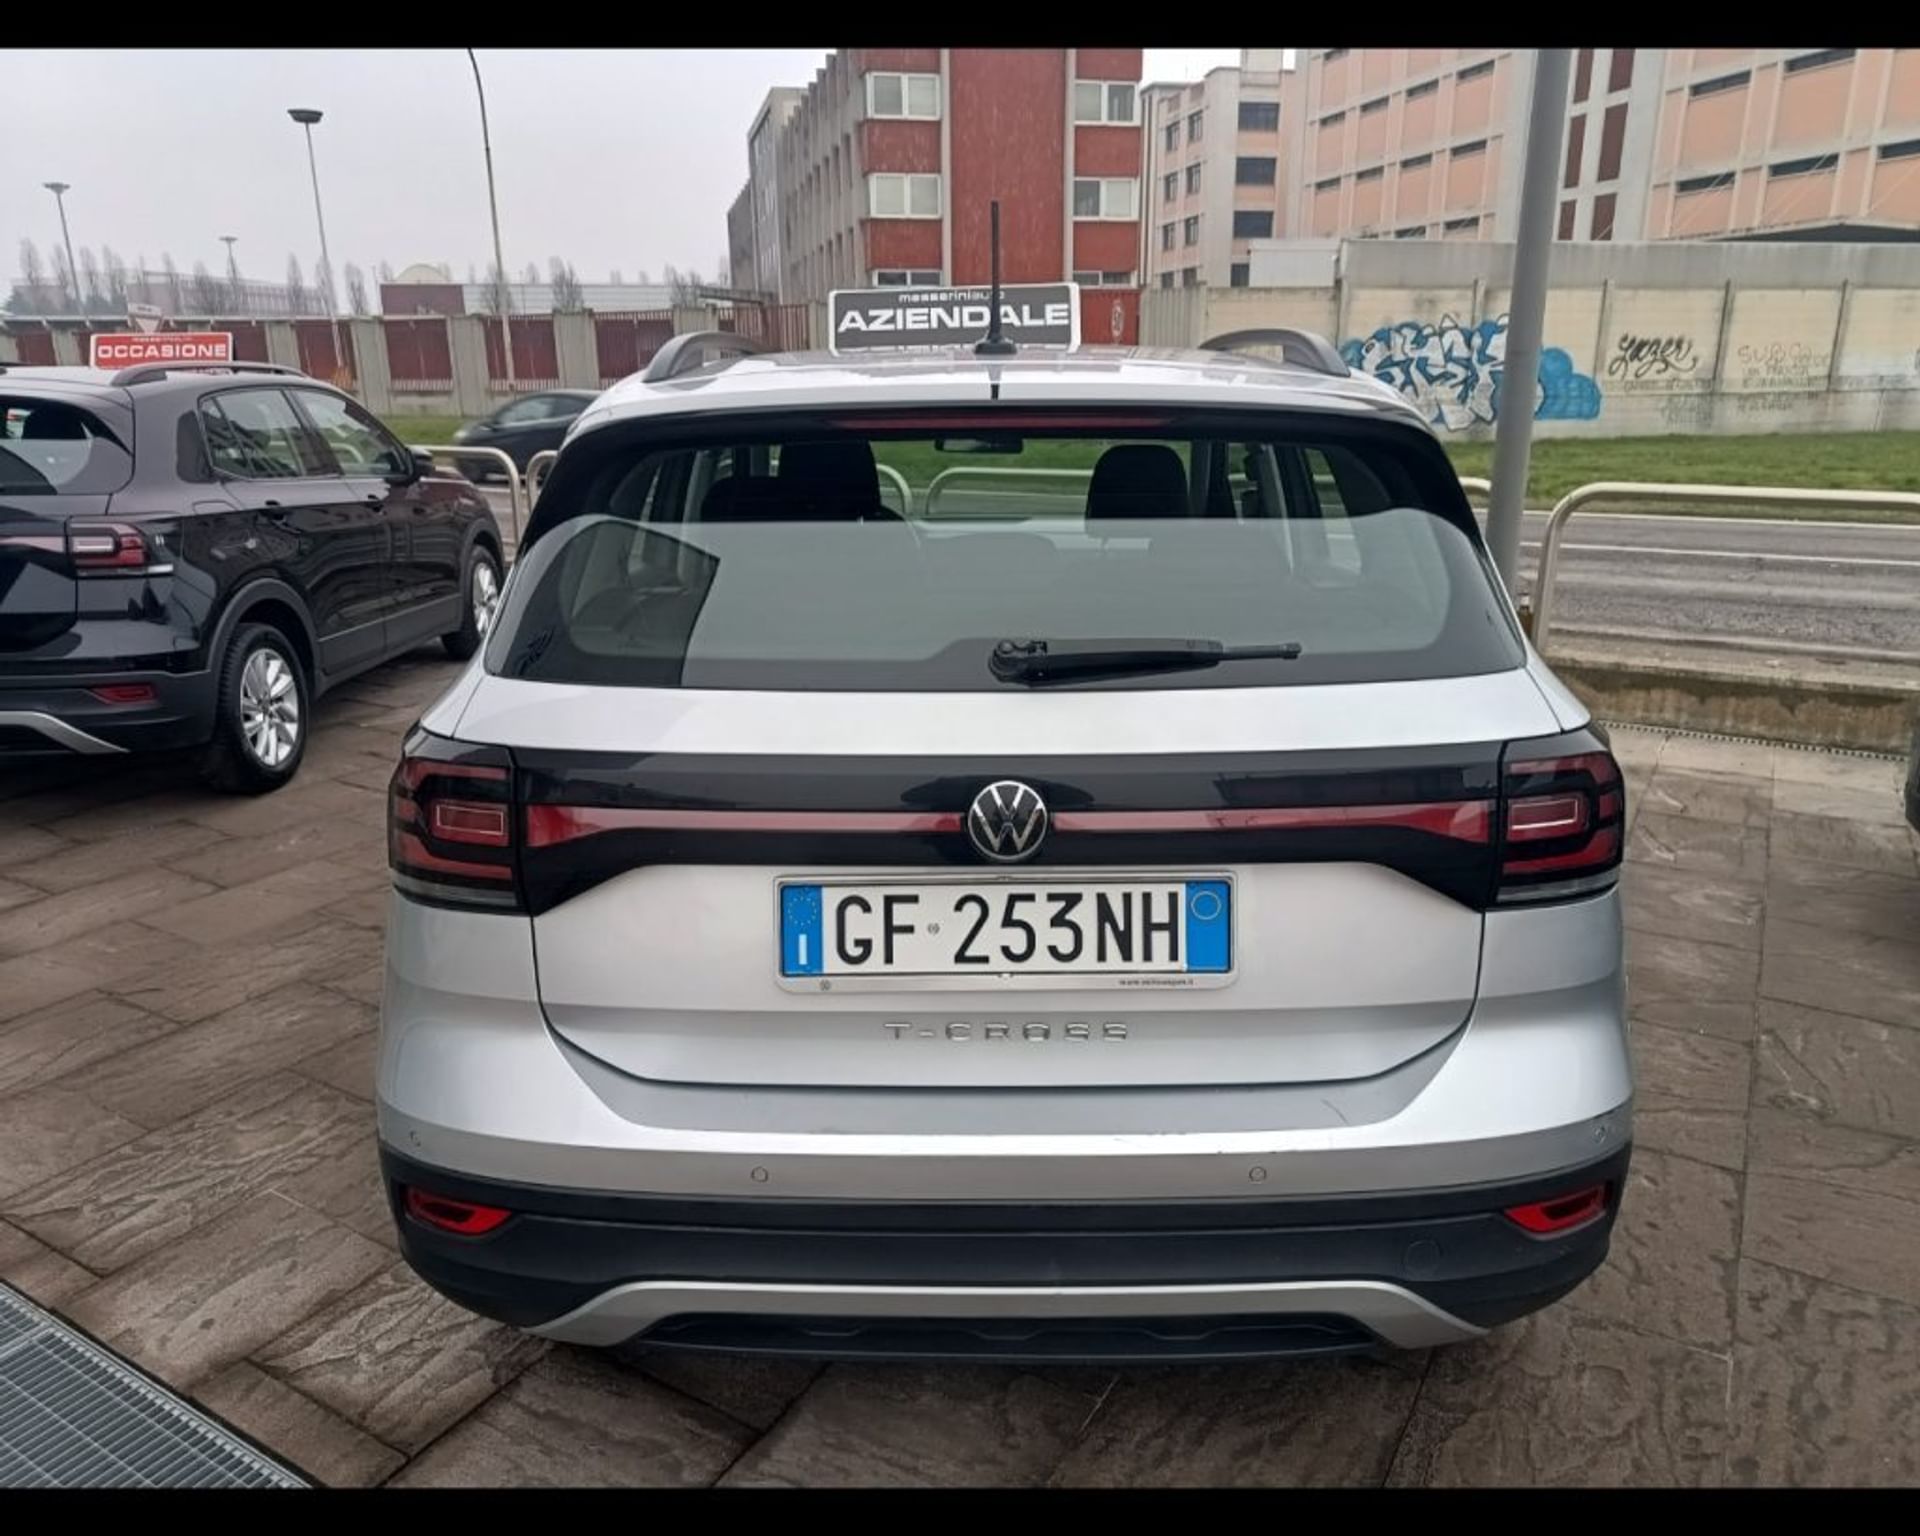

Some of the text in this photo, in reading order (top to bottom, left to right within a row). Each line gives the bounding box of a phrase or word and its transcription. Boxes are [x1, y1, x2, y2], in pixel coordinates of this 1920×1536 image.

[837, 303, 1070, 333] AZIENDALE
[97, 343, 227, 358] OCCASIONE
[835, 893, 920, 966] GF
[953, 891, 1180, 965] 253NH
[884, 1022, 1129, 1043] T-CROSS
